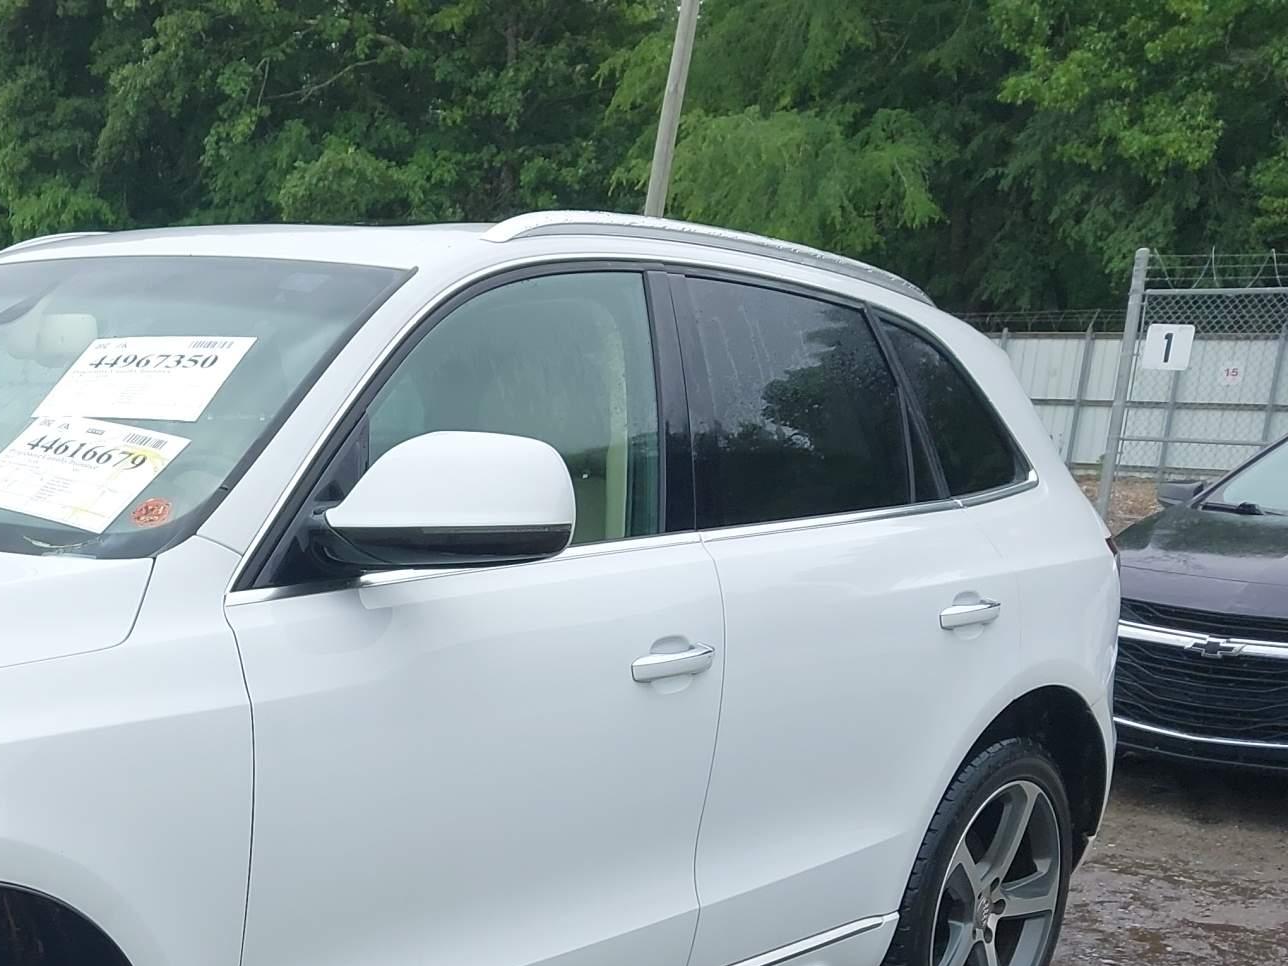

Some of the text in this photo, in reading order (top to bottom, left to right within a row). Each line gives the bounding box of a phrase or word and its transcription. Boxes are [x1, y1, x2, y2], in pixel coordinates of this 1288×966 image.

[1163, 333, 1173, 363] 1
[89, 354, 218, 369] 44967350
[1224, 368, 1239, 377] 15
[26, 434, 148, 470] 44616679
